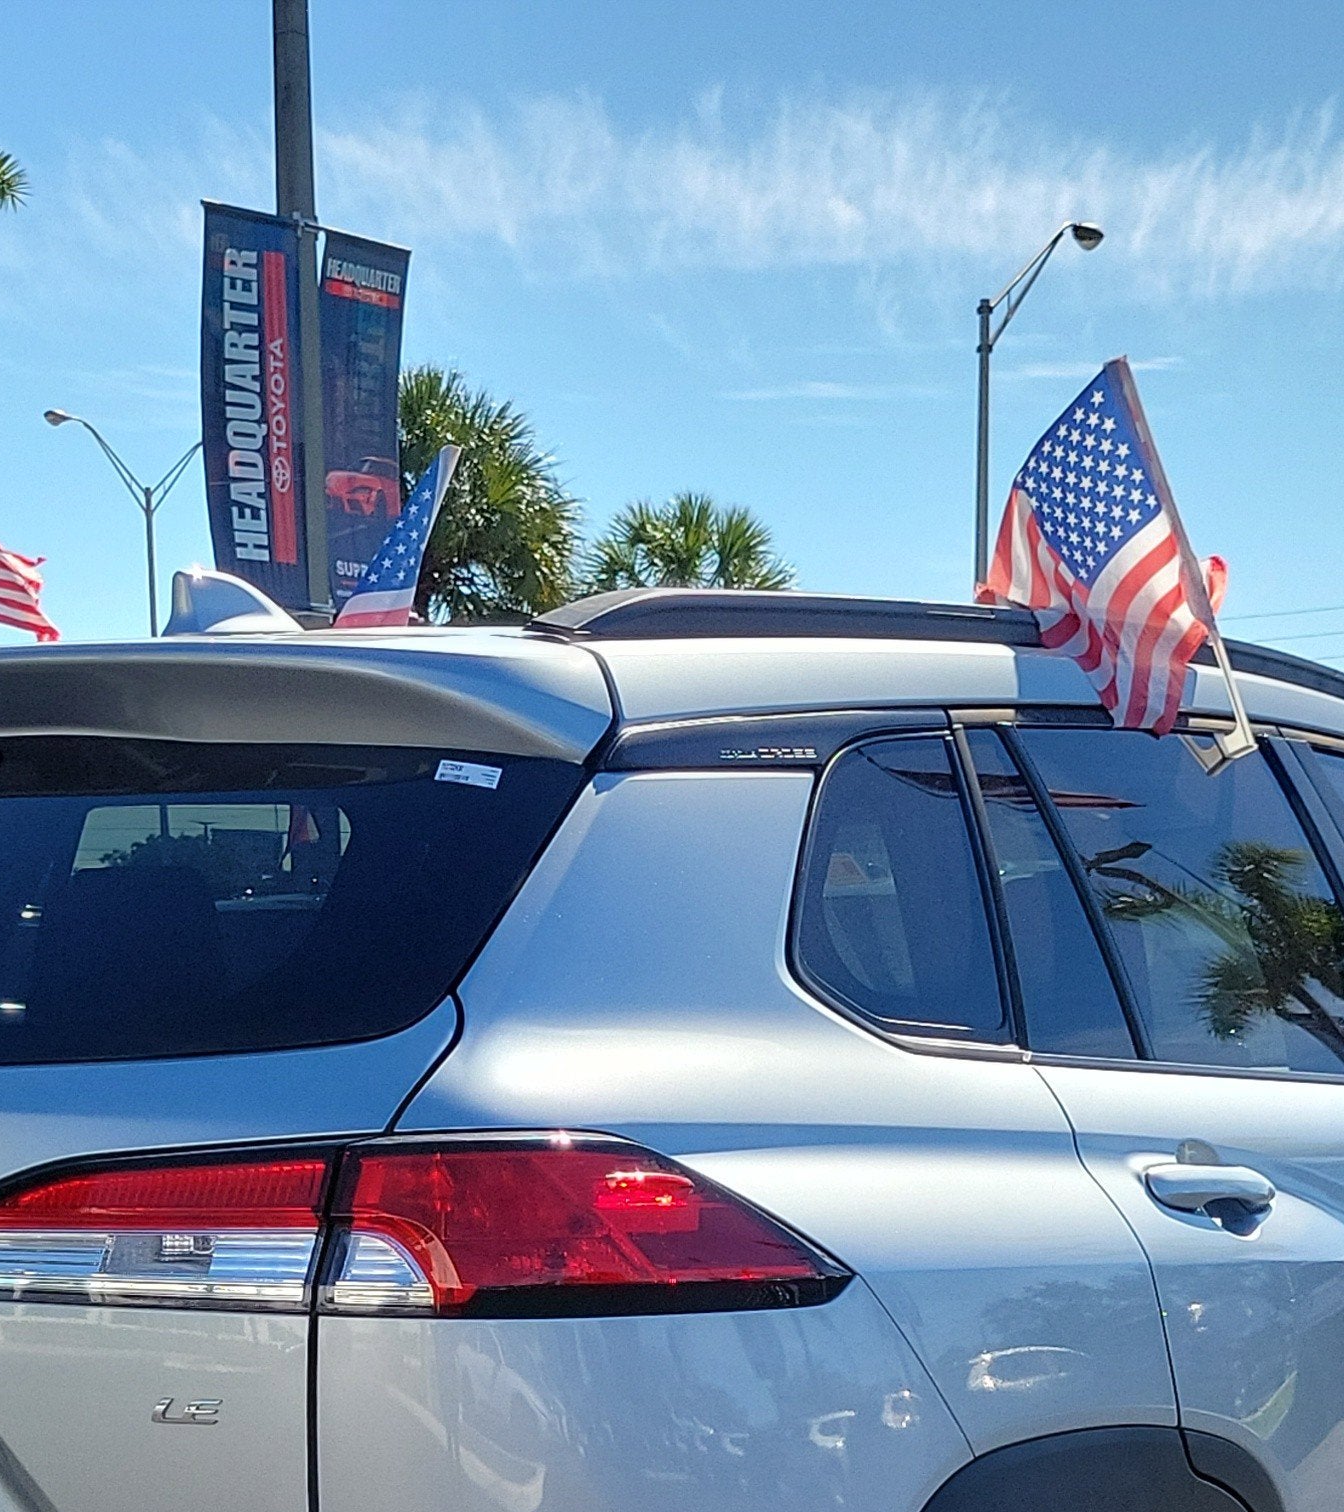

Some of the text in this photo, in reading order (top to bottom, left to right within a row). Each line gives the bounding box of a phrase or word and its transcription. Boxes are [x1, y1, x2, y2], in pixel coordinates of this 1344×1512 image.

[326, 257, 402, 294] HEADQUARTER
[223, 248, 270, 562] HEADQUARTER
[269, 338, 288, 454] TOYOTA
[151, 1397, 224, 1425] LE
